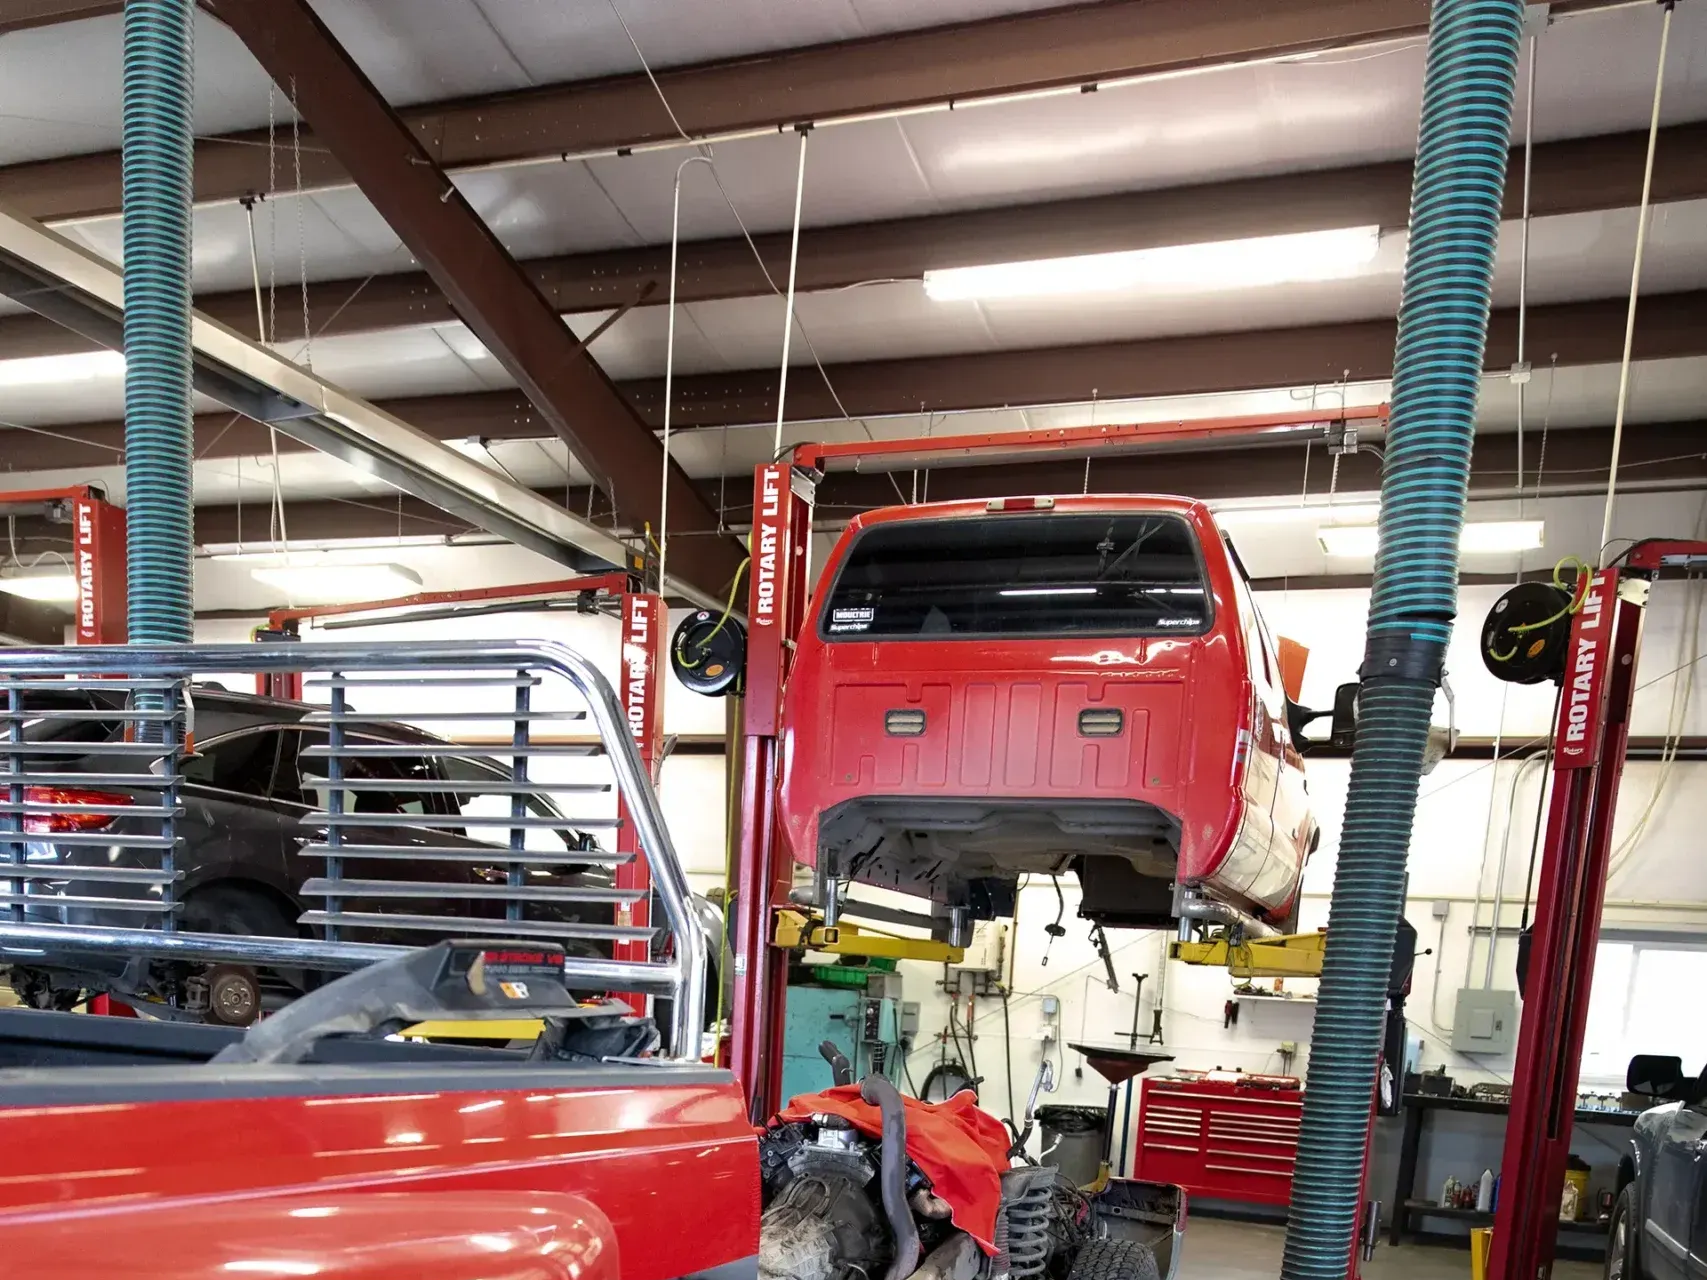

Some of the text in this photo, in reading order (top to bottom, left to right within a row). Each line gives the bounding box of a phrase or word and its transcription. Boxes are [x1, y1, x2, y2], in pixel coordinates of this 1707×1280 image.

[79, 503, 92, 545] LIFT
[757, 468, 780, 614] ROTARY LIFT
[80, 551, 94, 627] ROTARY
[631, 597, 649, 643] LIFT
[628, 649, 648, 737] ROTAR
[1566, 637, 1597, 742] ROTARY
